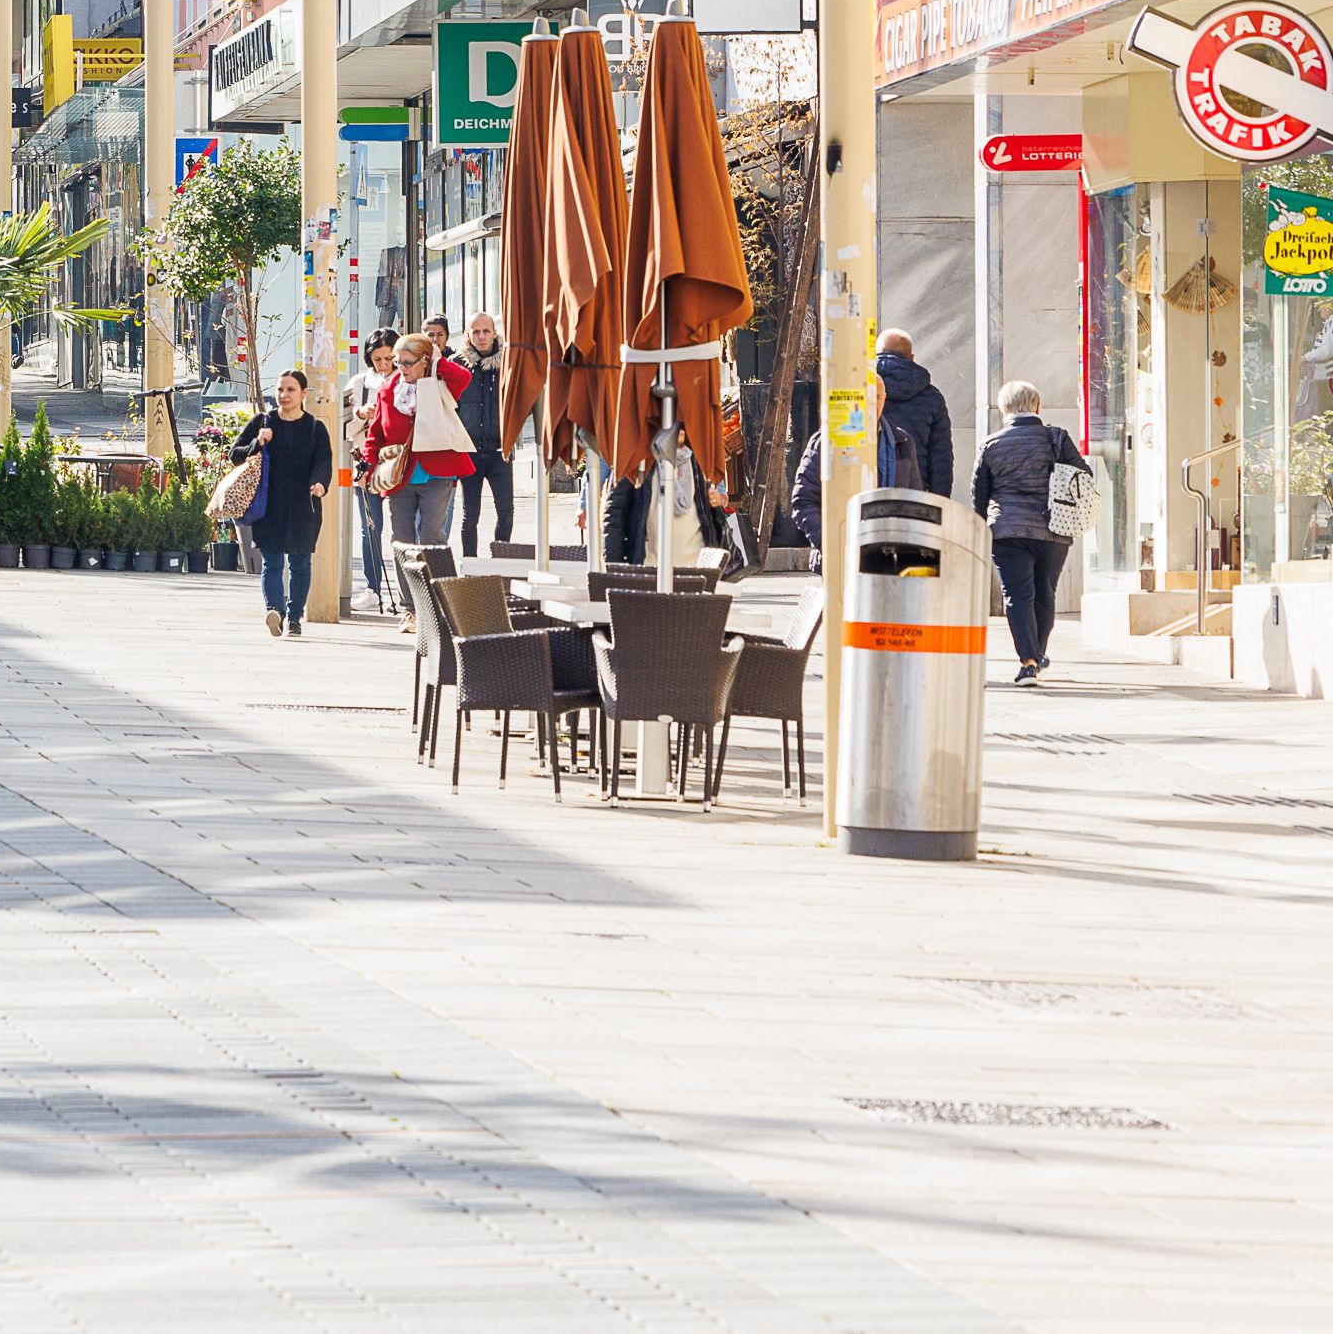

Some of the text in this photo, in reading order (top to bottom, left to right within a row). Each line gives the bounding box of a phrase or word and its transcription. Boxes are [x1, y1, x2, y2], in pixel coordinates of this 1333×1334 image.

[884, 9, 918, 74] CIGAR
[1210, 15, 1323, 74] TABAK
[1190, 67, 1294, 148] TRAFIK
[1282, 277, 1327, 294] LOTTO
